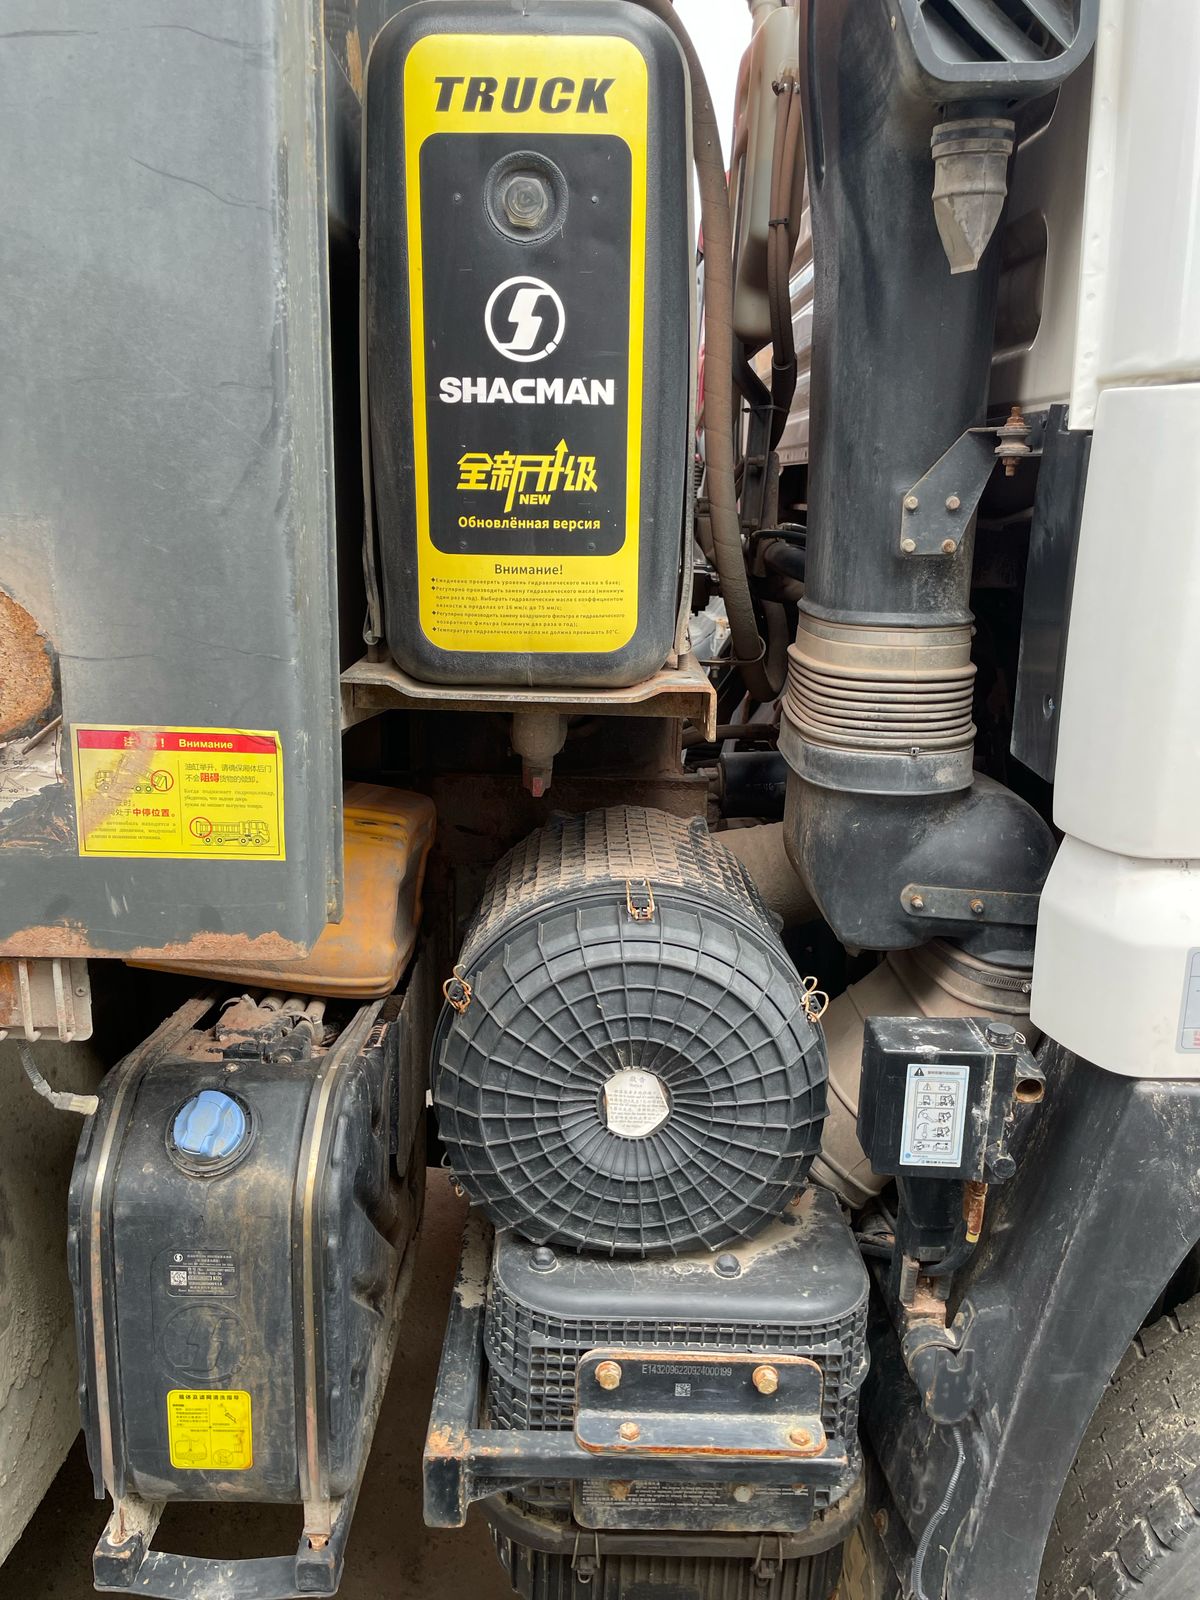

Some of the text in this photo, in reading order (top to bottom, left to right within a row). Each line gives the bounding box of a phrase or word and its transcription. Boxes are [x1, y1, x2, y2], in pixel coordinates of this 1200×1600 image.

[434, 76, 616, 114] TRUCK
[439, 376, 615, 405] SHACMAN
[456, 438, 598, 513] 全新升级
[519, 494, 551, 505] NEW
[458, 515, 601, 532] Обновлённая версия
[494, 563, 564, 575] Внимание!
[179, 738, 234, 749] Внимание
